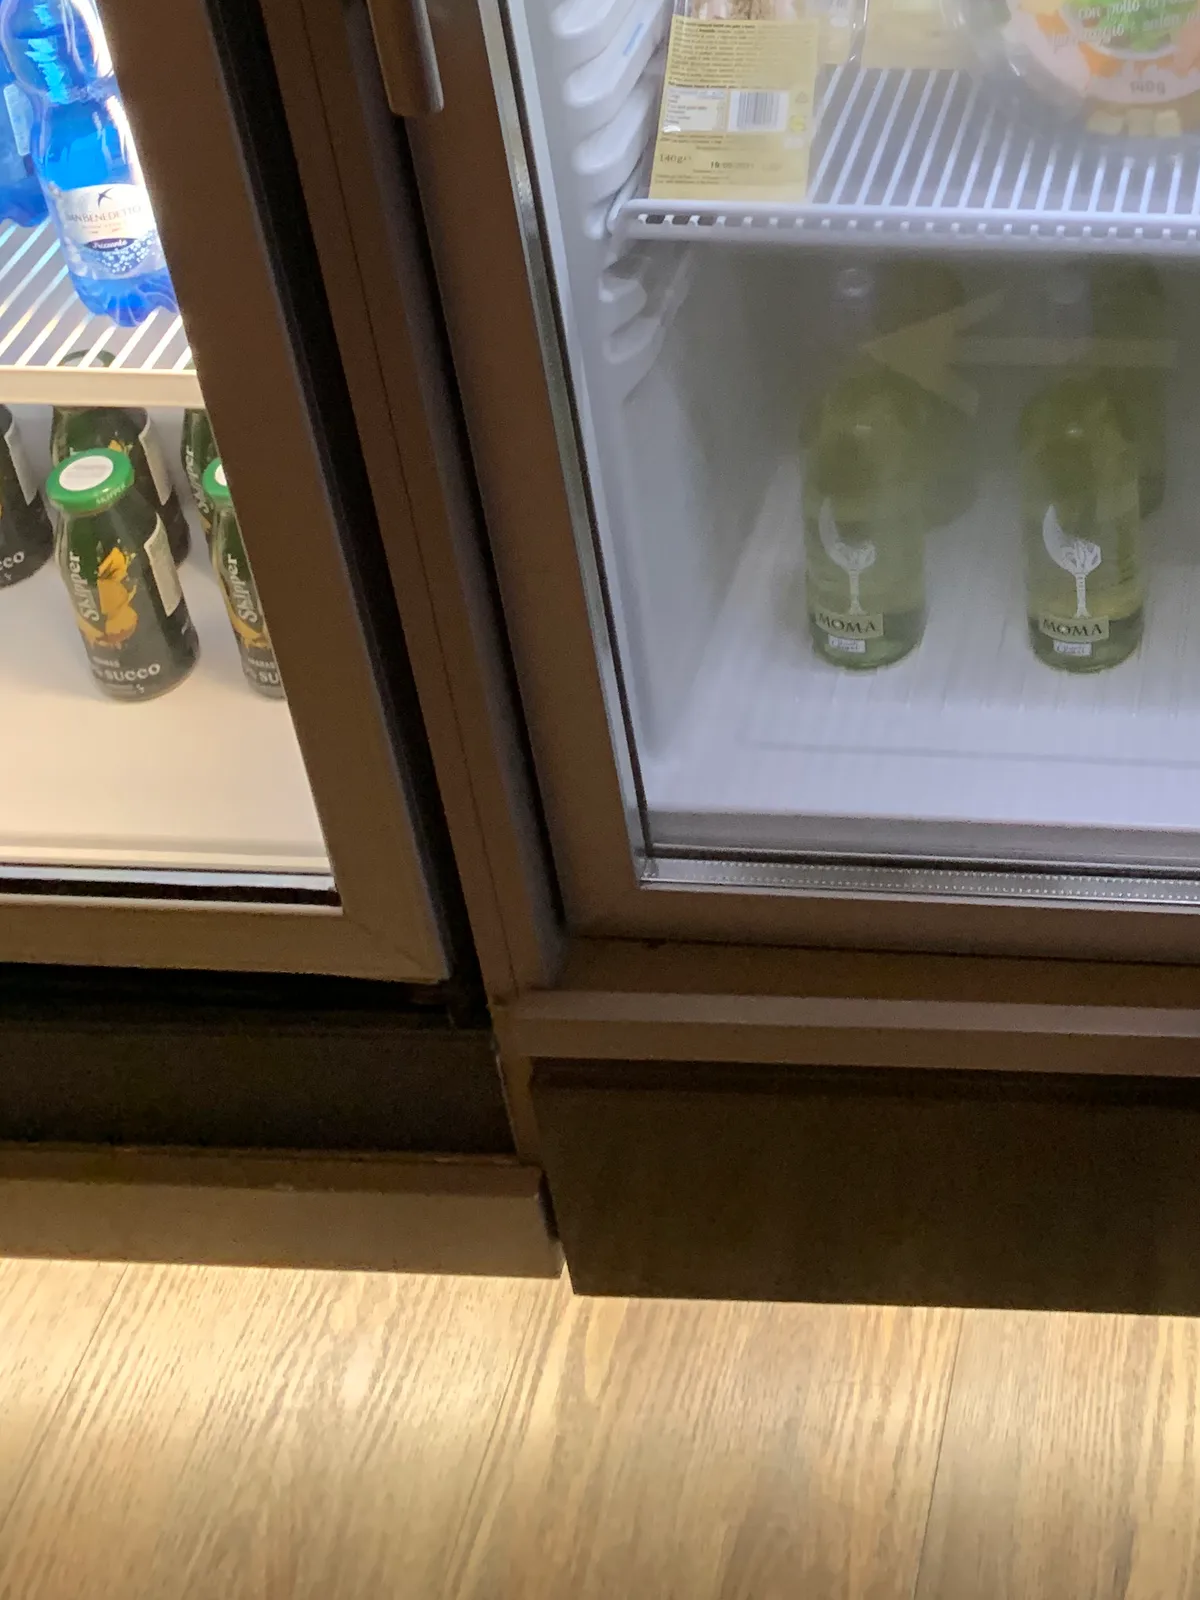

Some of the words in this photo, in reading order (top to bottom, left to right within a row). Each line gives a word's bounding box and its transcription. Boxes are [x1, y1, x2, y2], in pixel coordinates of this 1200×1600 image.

[819, 613, 877, 634] MOMA
[1042, 619, 1103, 637] MOMA
[104, 663, 161, 681] SUCCO
